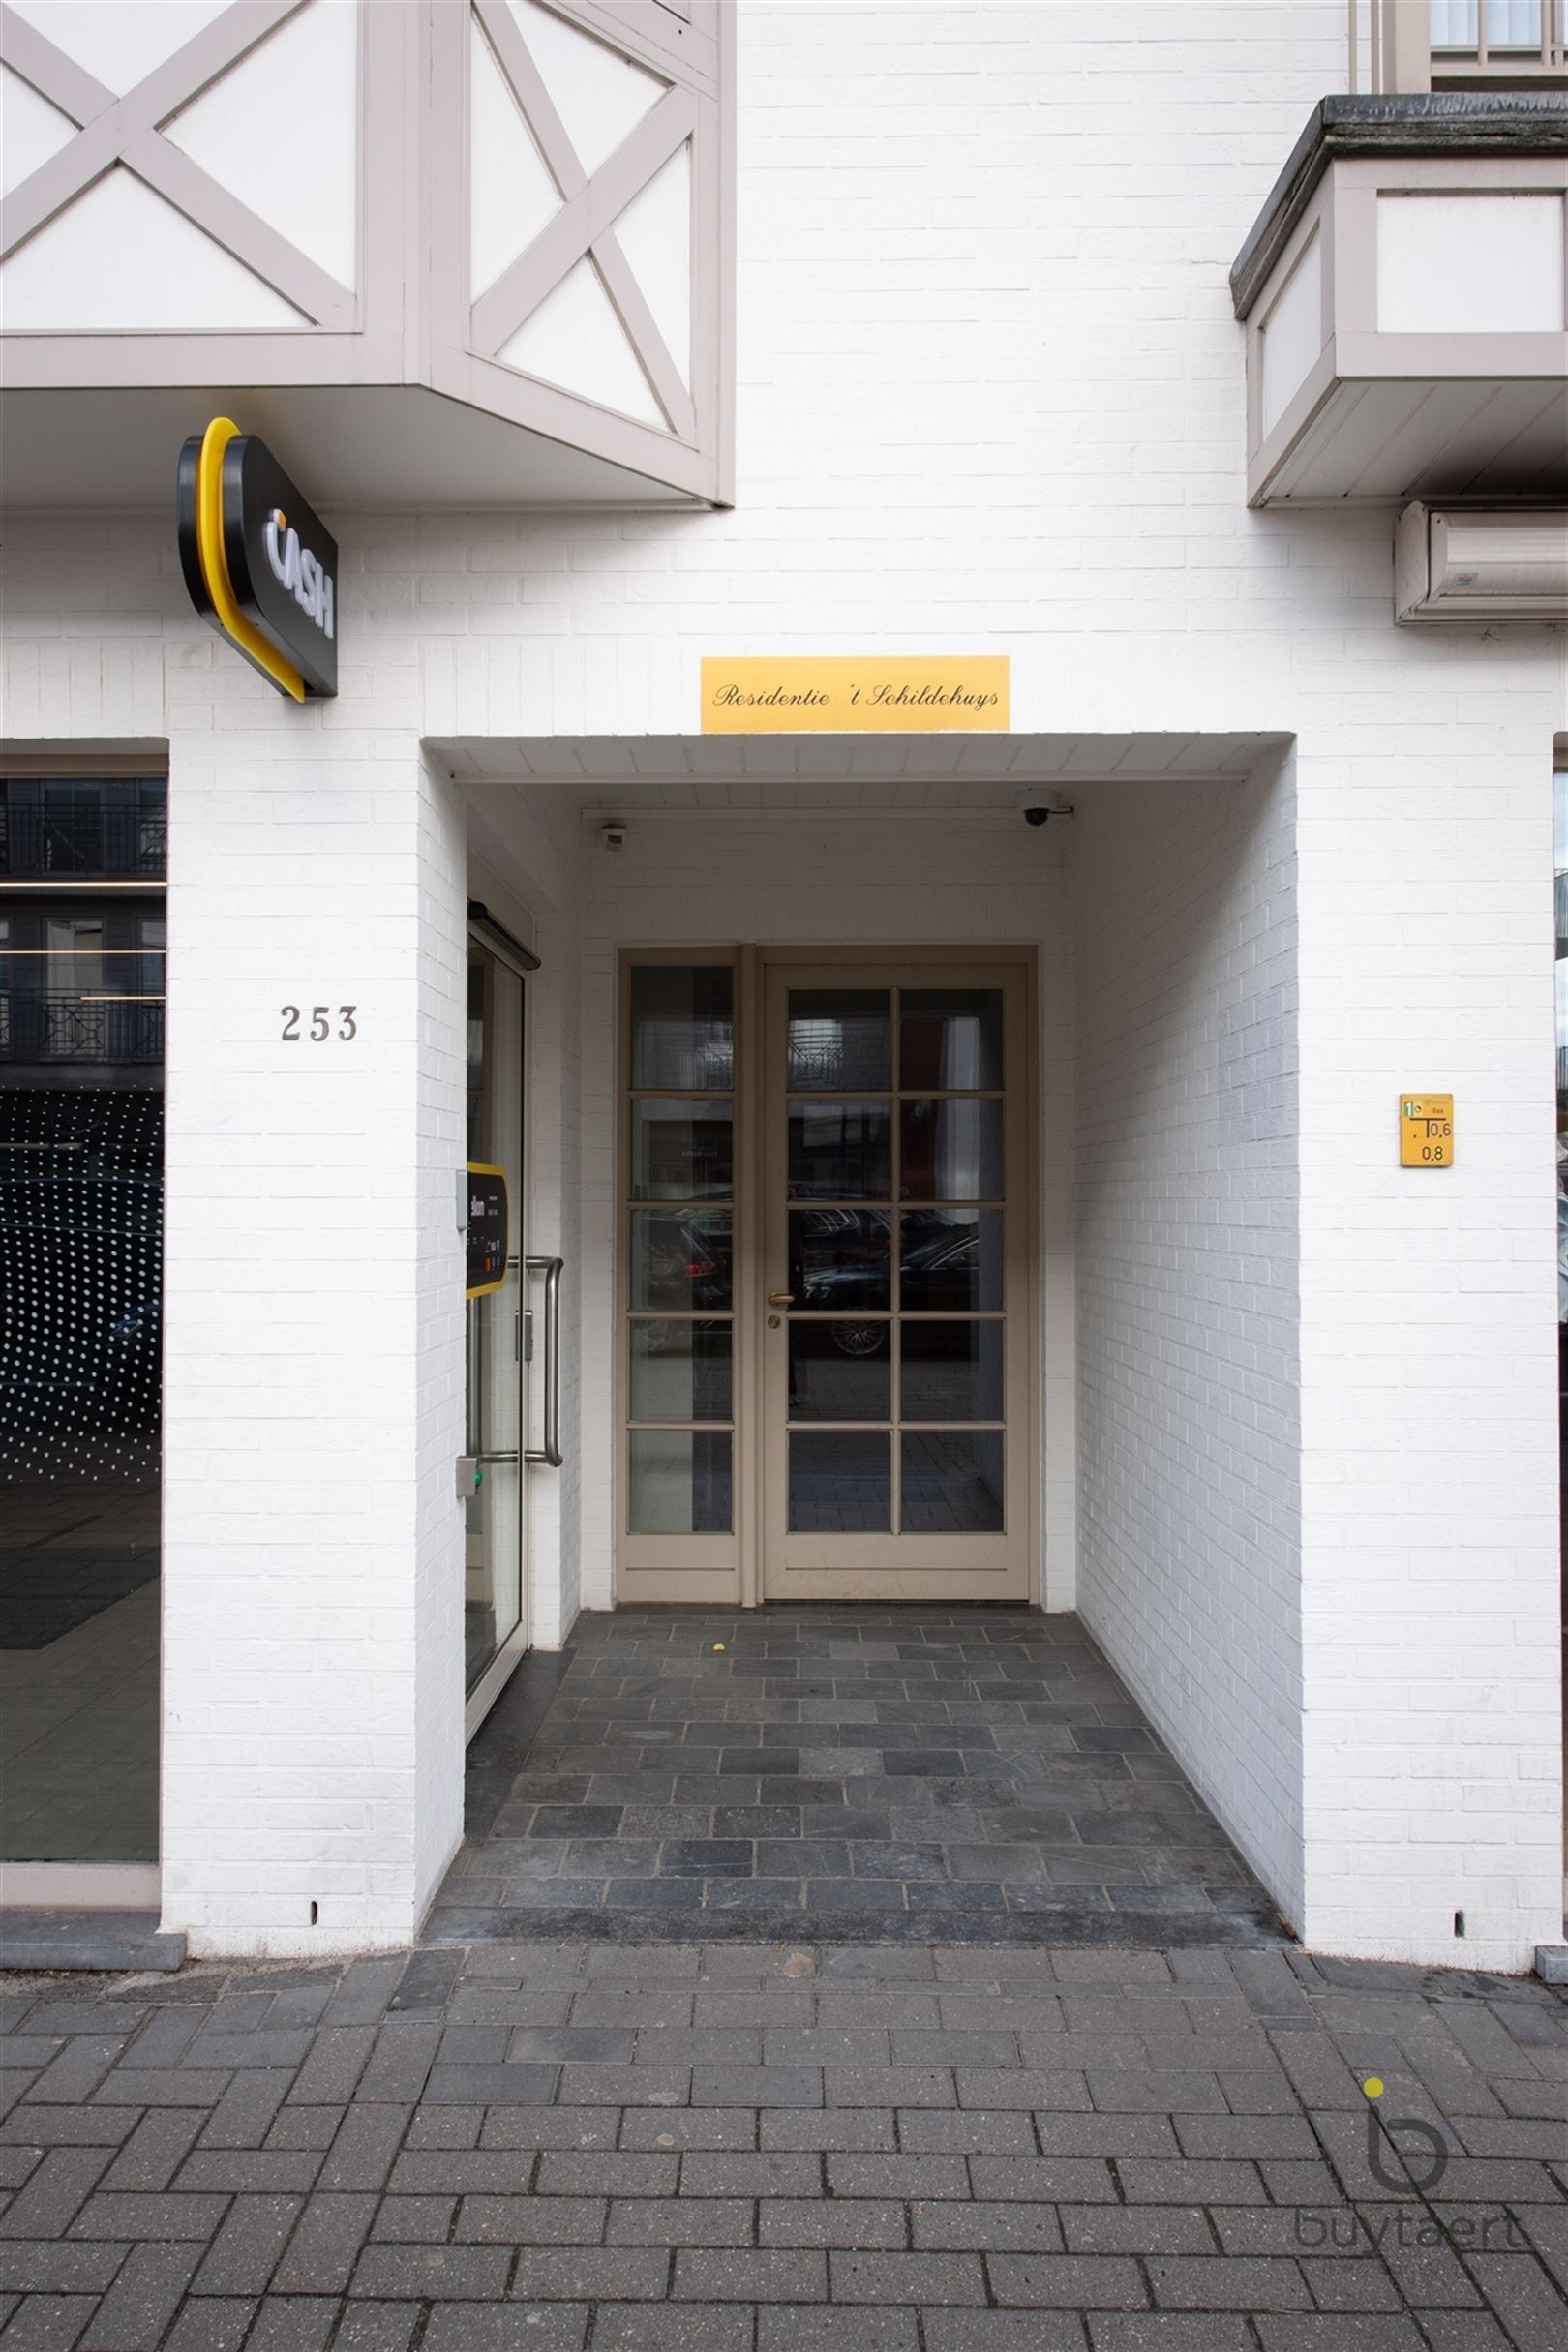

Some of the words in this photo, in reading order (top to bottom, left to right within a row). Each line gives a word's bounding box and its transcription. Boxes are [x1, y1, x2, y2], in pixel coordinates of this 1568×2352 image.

[712, 683, 830, 707] Residentie
[865, 683, 998, 711] Schildehuys
[281, 1005, 357, 1042] 253
